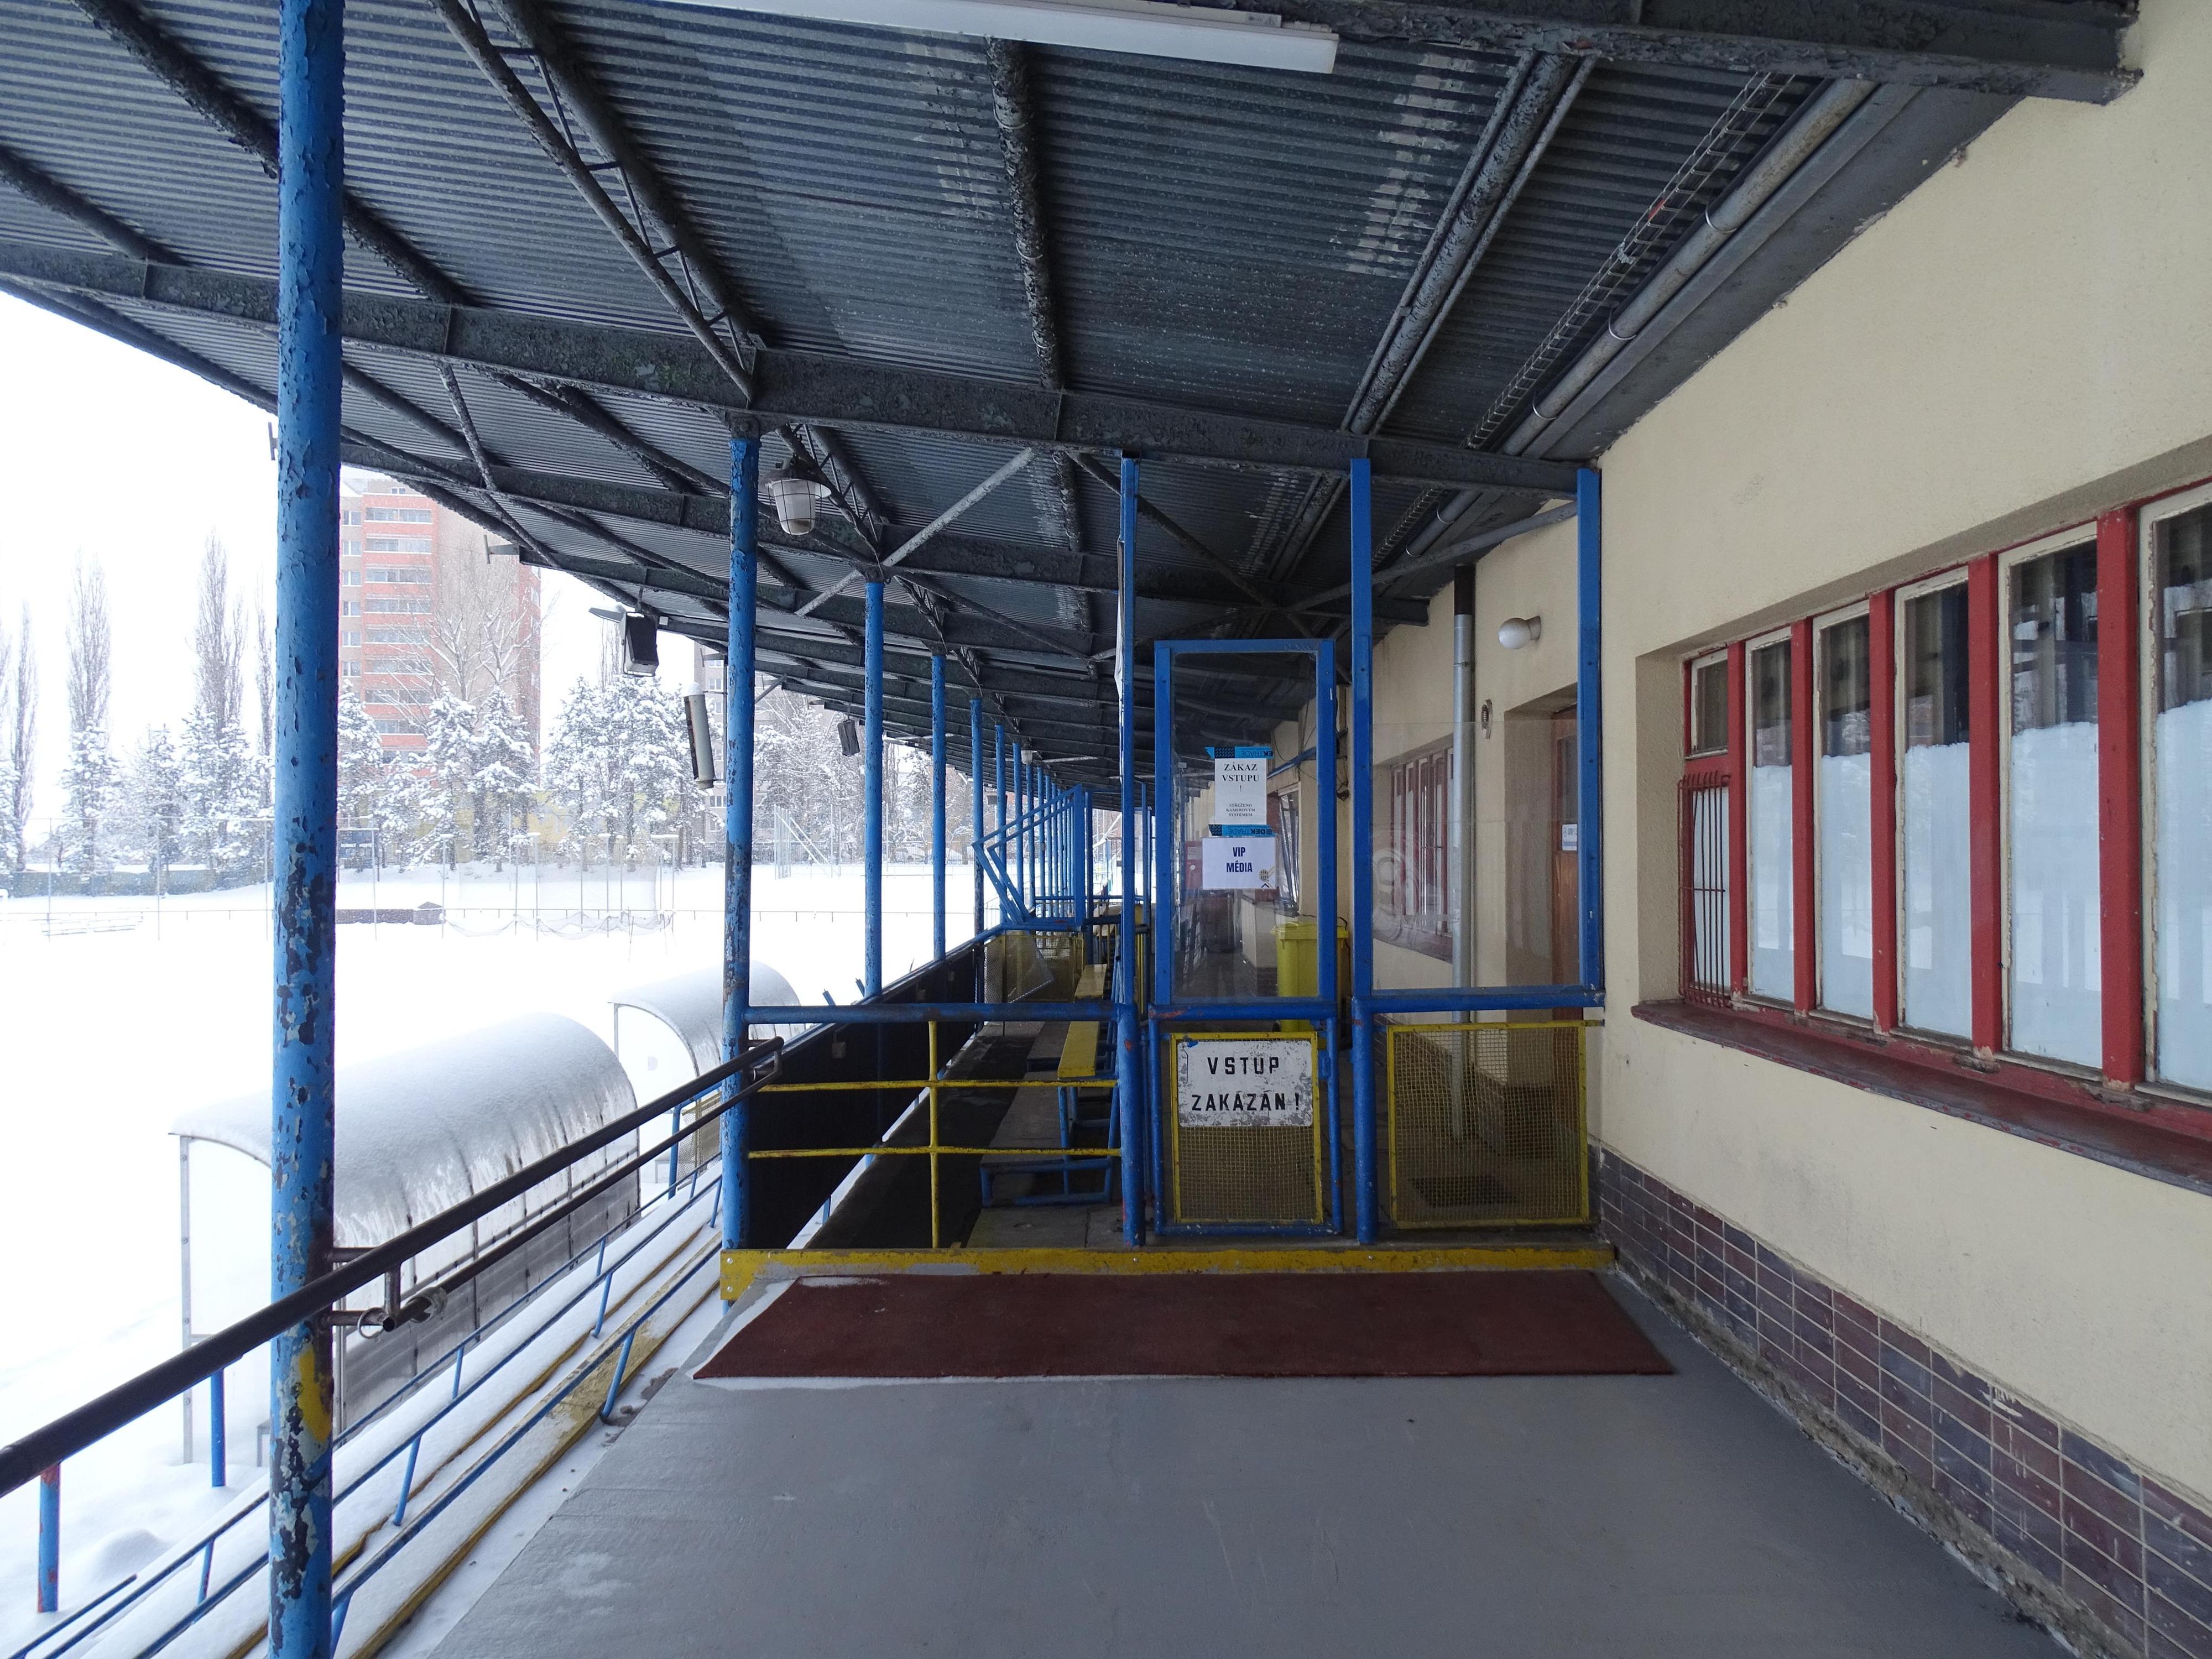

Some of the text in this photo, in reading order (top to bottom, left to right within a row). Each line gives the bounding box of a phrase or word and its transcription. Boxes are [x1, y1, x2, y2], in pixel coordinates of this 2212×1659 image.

[1224, 761, 1258, 771] ZÁKAZ
[1233, 847, 1246, 857] VIP
[1226, 860, 1253, 873] MÉDIA
[1207, 1056, 1280, 1075] VSTUP
